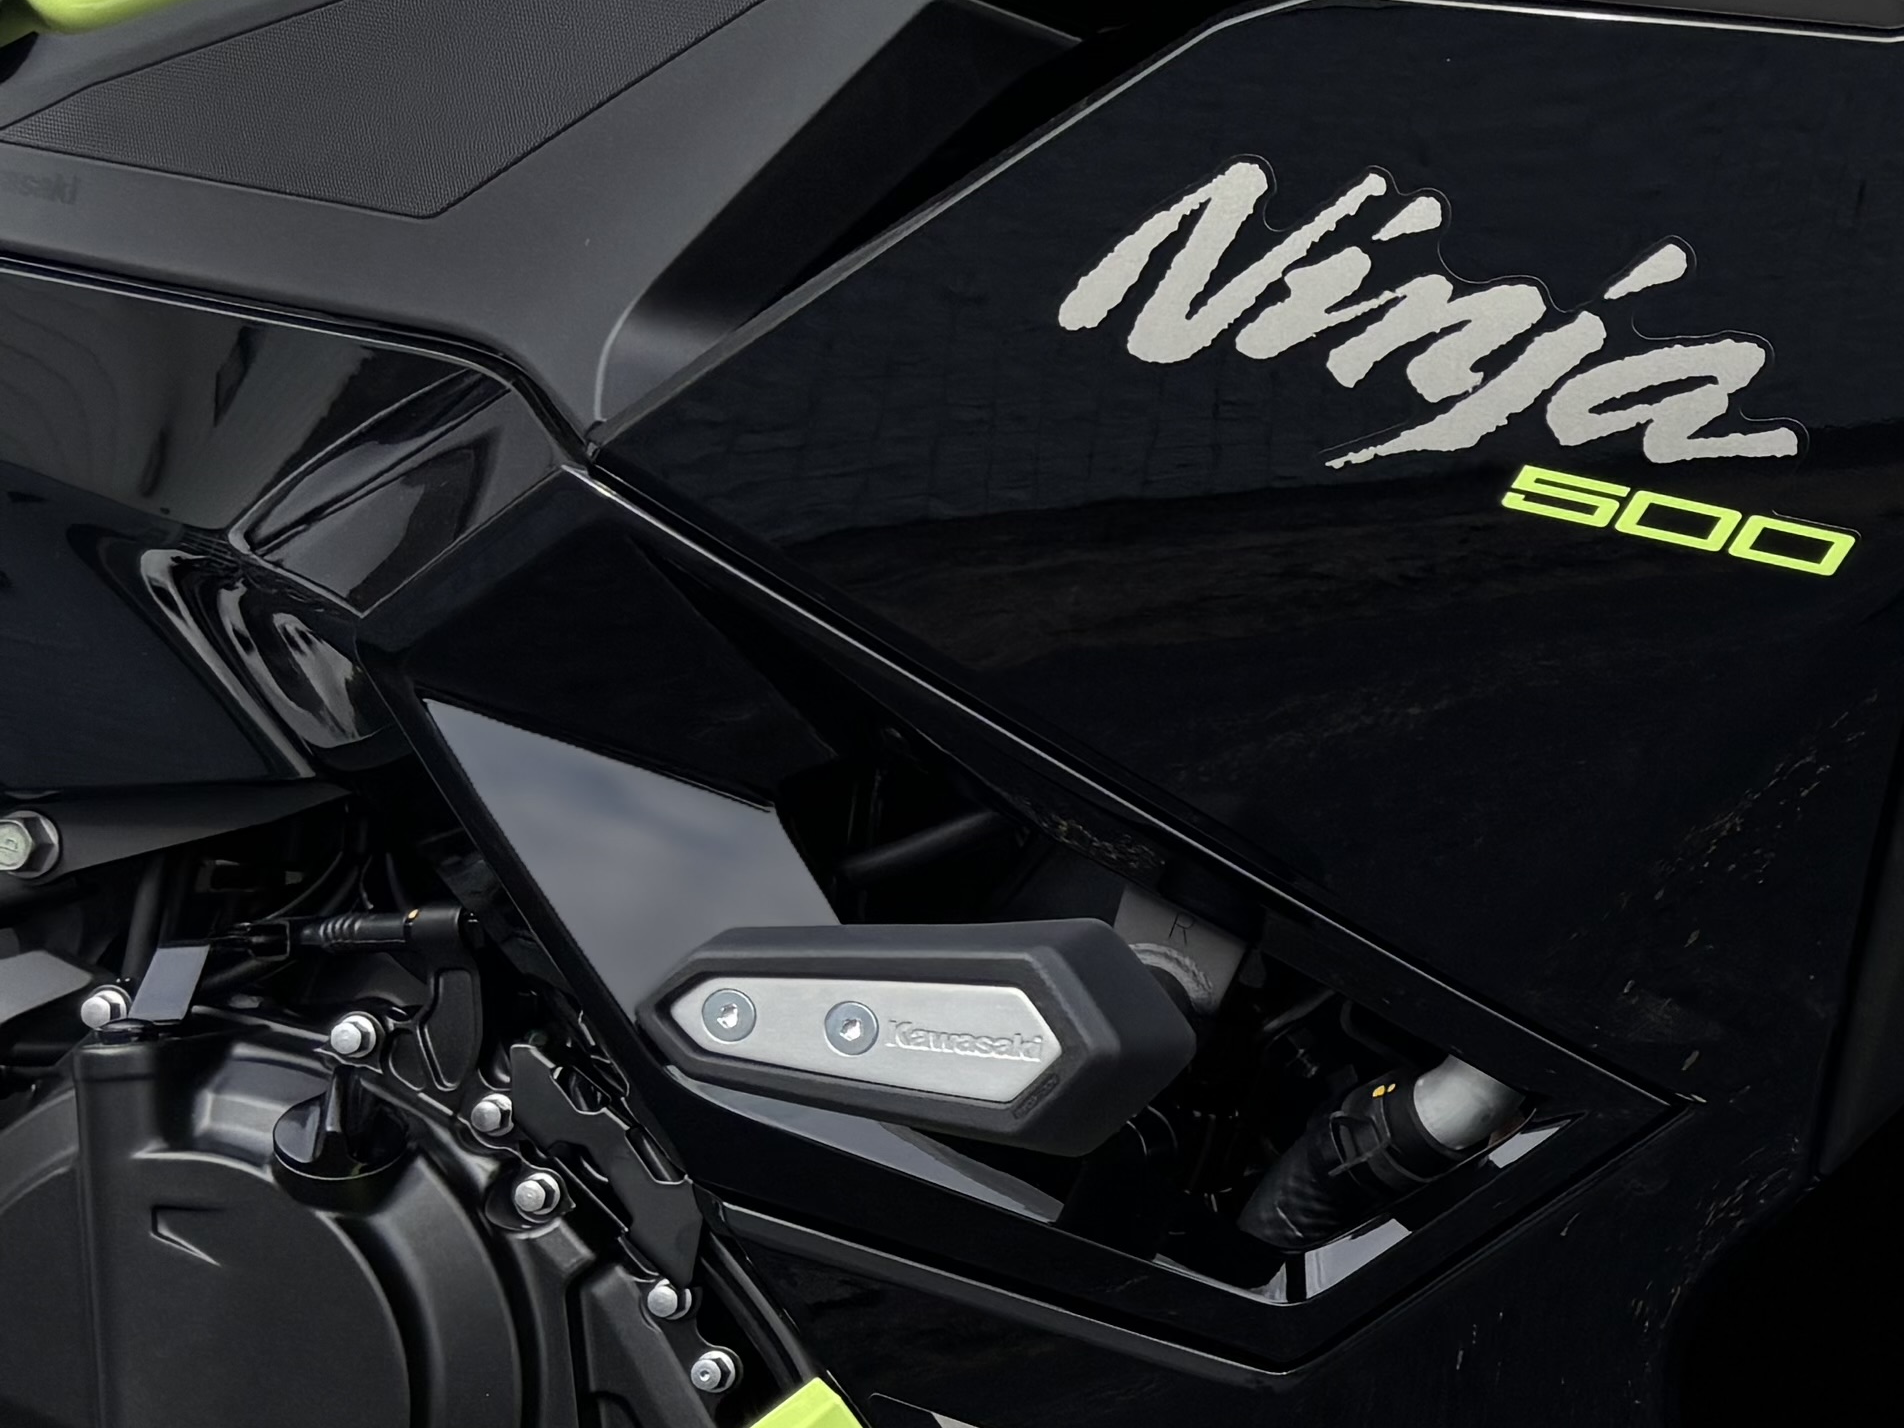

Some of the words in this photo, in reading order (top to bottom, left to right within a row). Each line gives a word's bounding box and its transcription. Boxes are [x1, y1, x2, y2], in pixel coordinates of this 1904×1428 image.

[1058, 160, 1798, 469] Ninja
[1501, 464, 1857, 576] 500
[1168, 913, 1191, 946] R
[886, 1018, 1042, 1062] Kawasaki
